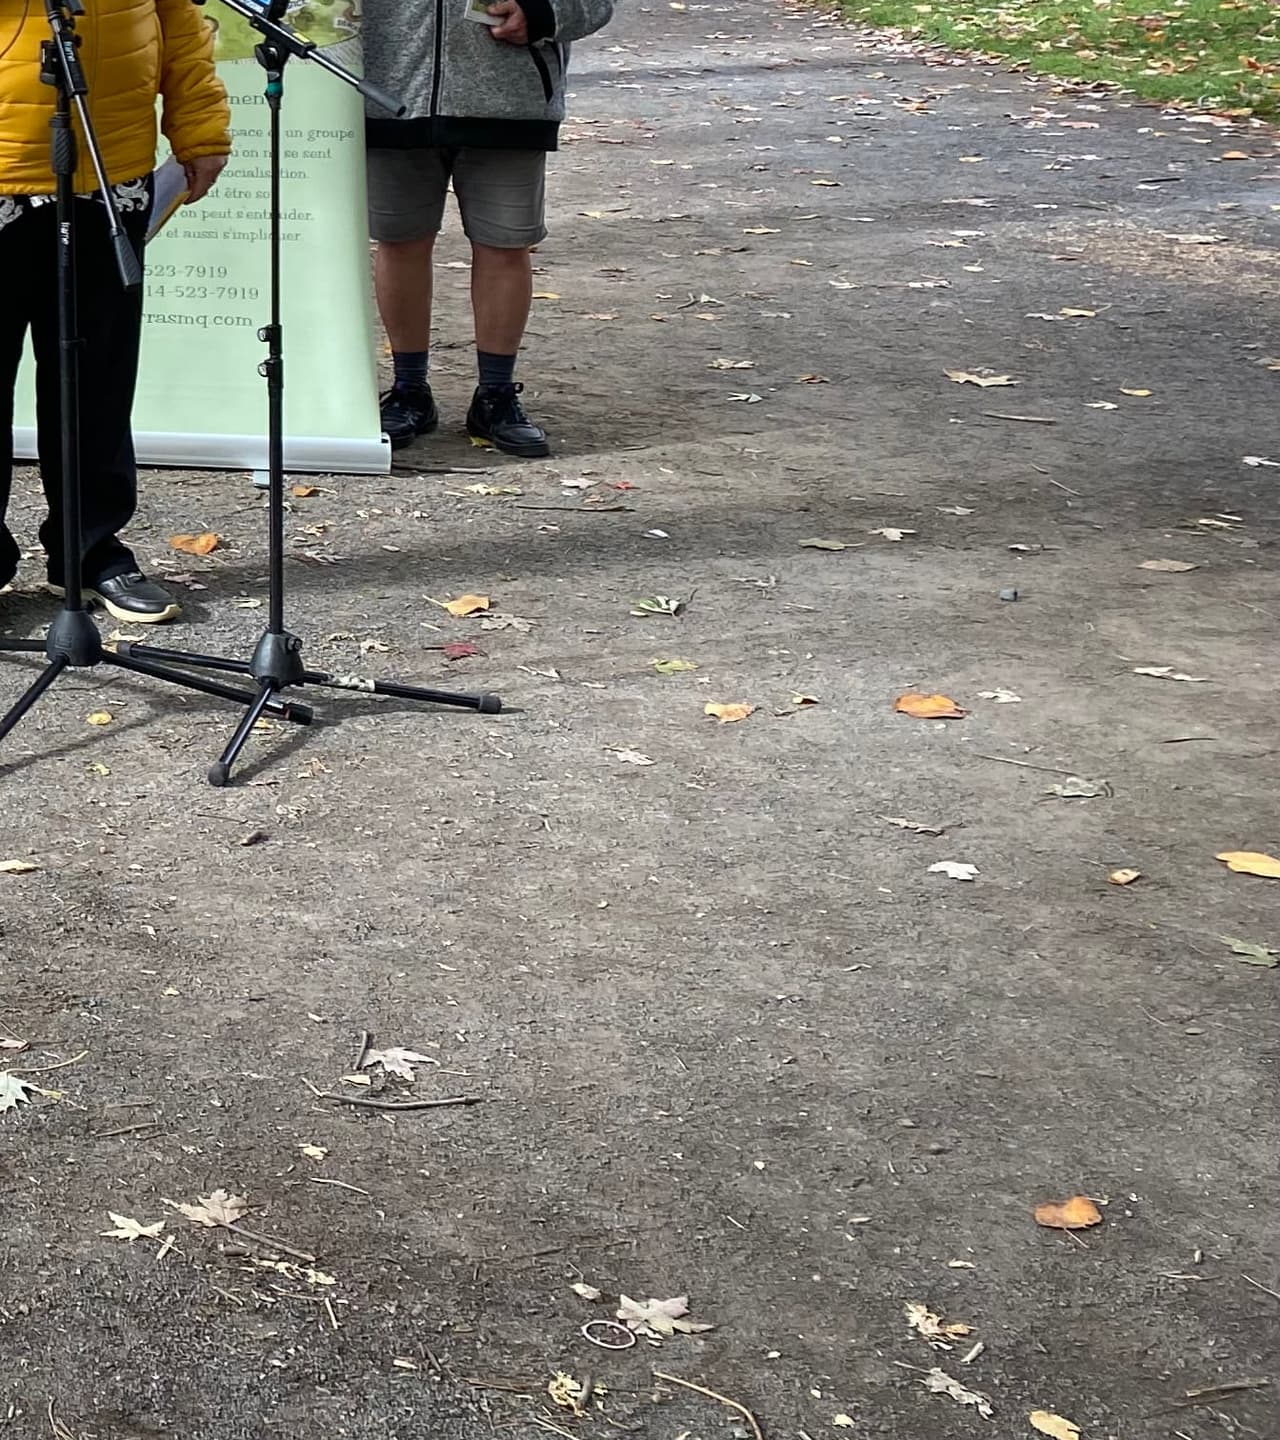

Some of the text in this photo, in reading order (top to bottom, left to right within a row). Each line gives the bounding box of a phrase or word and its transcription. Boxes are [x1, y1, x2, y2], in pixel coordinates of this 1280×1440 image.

[231, 129, 355, 141] pace un groupe
[242, 148, 333, 159] on se sent
[224, 187, 252, 198] être
[181, 210, 197, 218] on
[202, 209, 231, 221] peut
[166, 229, 179, 239] et
[183, 229, 218, 239] aussi
[146, 285, 259, 300] 14-523-7919
